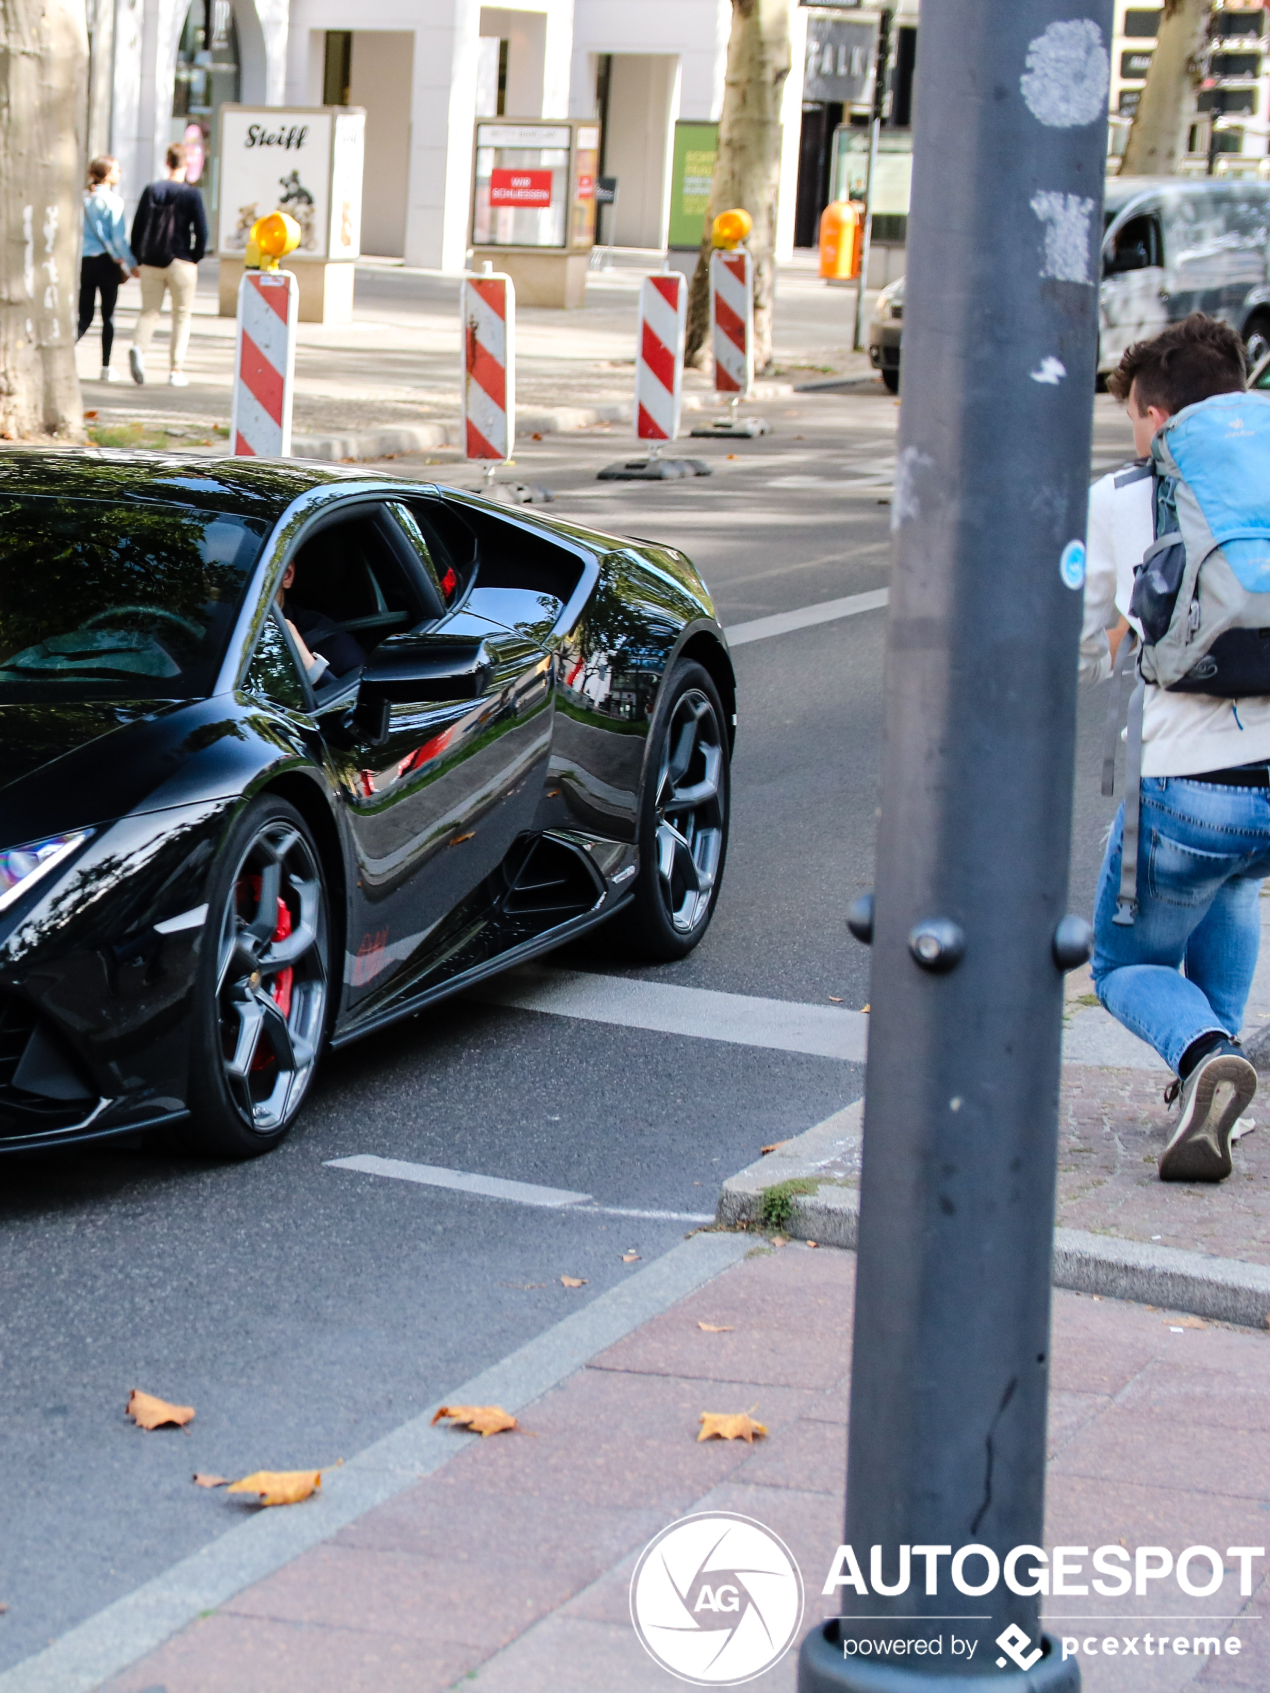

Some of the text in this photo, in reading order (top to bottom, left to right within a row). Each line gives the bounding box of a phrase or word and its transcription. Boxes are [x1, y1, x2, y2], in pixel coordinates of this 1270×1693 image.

[245, 124, 308, 149] Steiff
[511, 177, 532, 188] WIR
[492, 188, 550, 200] SCHLIESSEN
